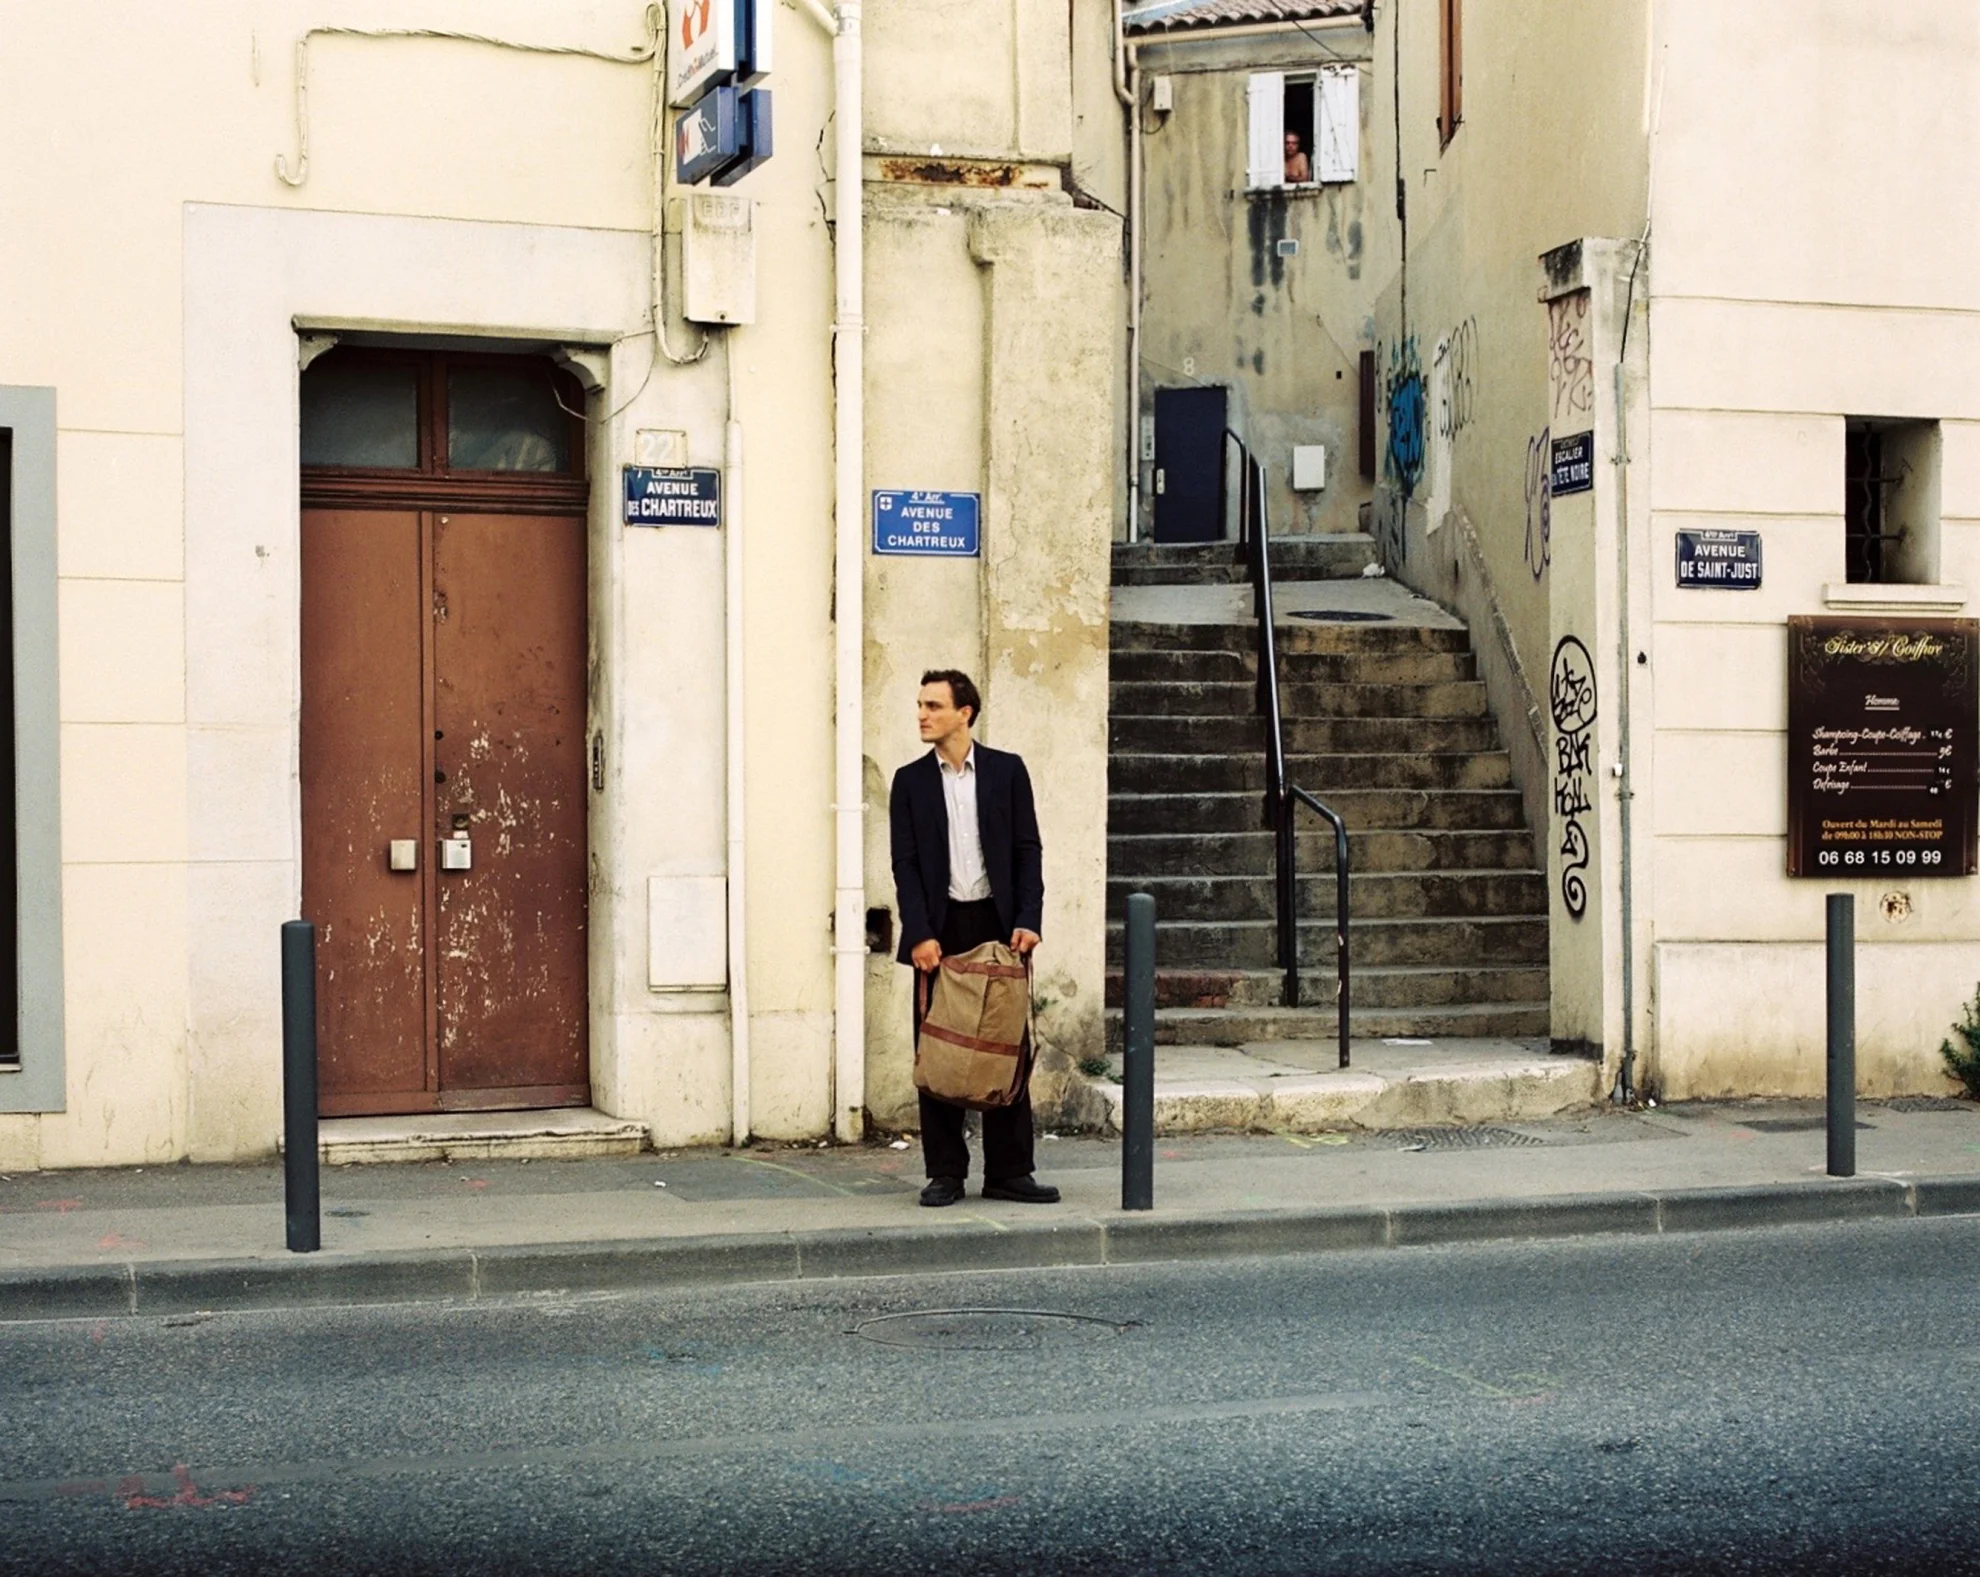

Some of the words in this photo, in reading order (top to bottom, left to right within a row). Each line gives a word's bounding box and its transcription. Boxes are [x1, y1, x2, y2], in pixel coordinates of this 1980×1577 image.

[1183, 356, 1194, 376] 8
[640, 433, 675, 463] 22
[1555, 446, 1583, 464] ESCALIER
[1571, 462, 1589, 481] NOIRE
[646, 482, 699, 496] AVENUE
[641, 498, 717, 518] CHARTREUX
[901, 506, 953, 520] AVENUE
[913, 521, 941, 533] DES
[887, 535, 966, 549] CHARTREUX
[1694, 544, 1746, 558] AVENUE
[1681, 561, 1694, 578] DE
[1697, 561, 1758, 579] SAINT-JUST
[1892, 634, 1944, 661] Coiffure
[1865, 694, 1900, 706] Homme
[1813, 743, 1839, 756] Barbe
[1812, 761, 1837, 777] Coupe
[1838, 760, 1868, 775] Enfant
[1822, 819, 1854, 828] Ouvert
[1855, 819, 1868, 828] du
[1870, 819, 1897, 828] Mardi
[1898, 820, 1909, 828] au
[1910, 819, 1943, 828] Samedi
[1821, 830, 1833, 840] de
[1895, 830, 1944, 840] NON-STOP
[1818, 850, 1840, 865] 06
[1844, 850, 1865, 865] 68
[1871, 850, 1891, 865] 15
[1895, 850, 1916, 865] 09
[1921, 850, 1942, 865] 99
